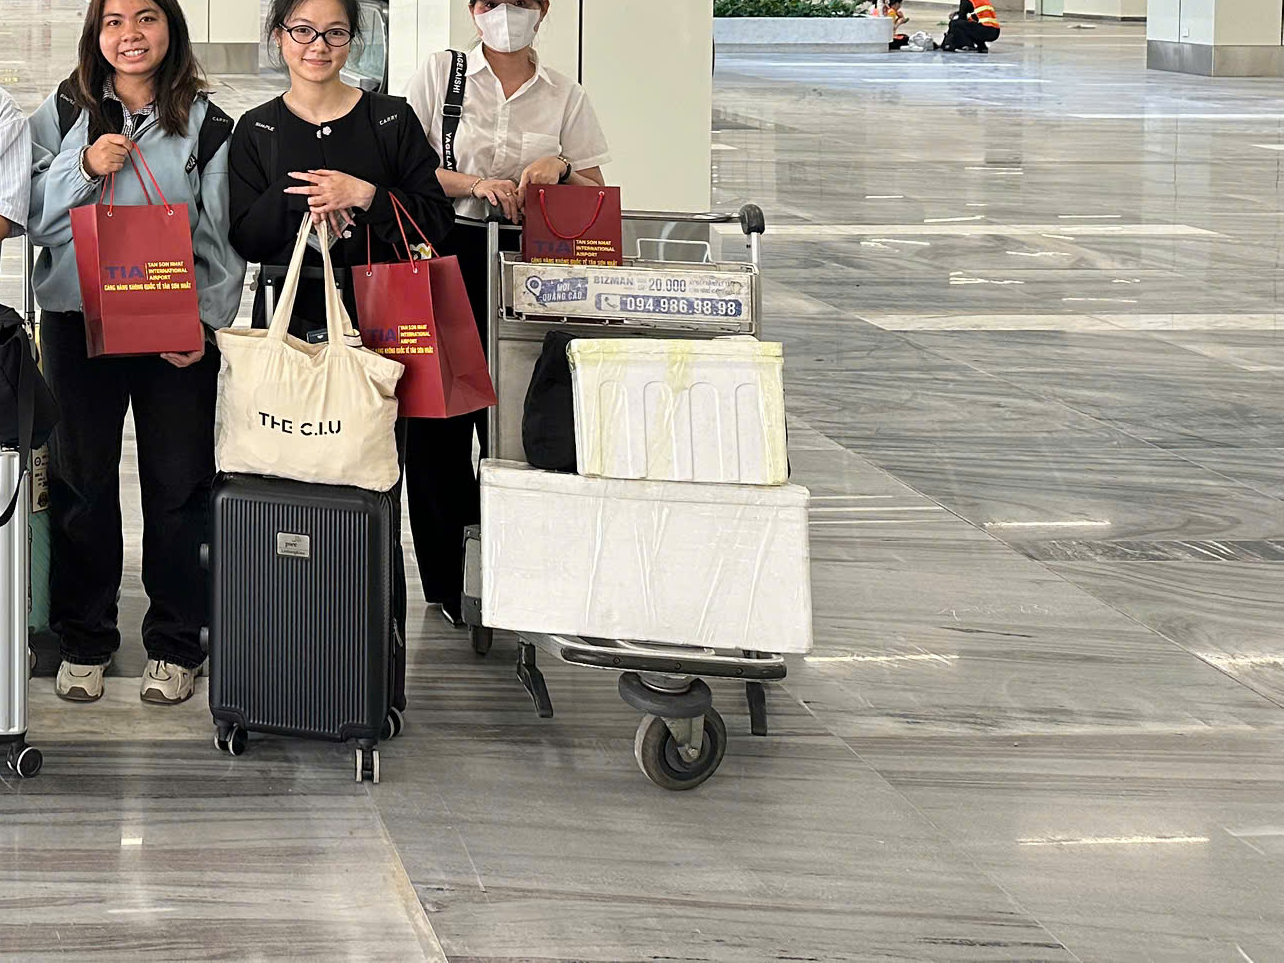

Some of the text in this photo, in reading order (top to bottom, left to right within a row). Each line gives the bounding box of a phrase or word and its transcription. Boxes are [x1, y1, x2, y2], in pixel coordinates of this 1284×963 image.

[379, 114, 398, 126] CARRY
[533, 240, 571, 253] TIA
[106, 265, 145, 279] TIA
[593, 275, 633, 286] BIZMAN
[648, 278, 686, 293] 20.000
[626, 297, 736, 316] 094.986.98.98
[366, 328, 396, 342] TIA
[259, 411, 341, 436] THE C.I.U
